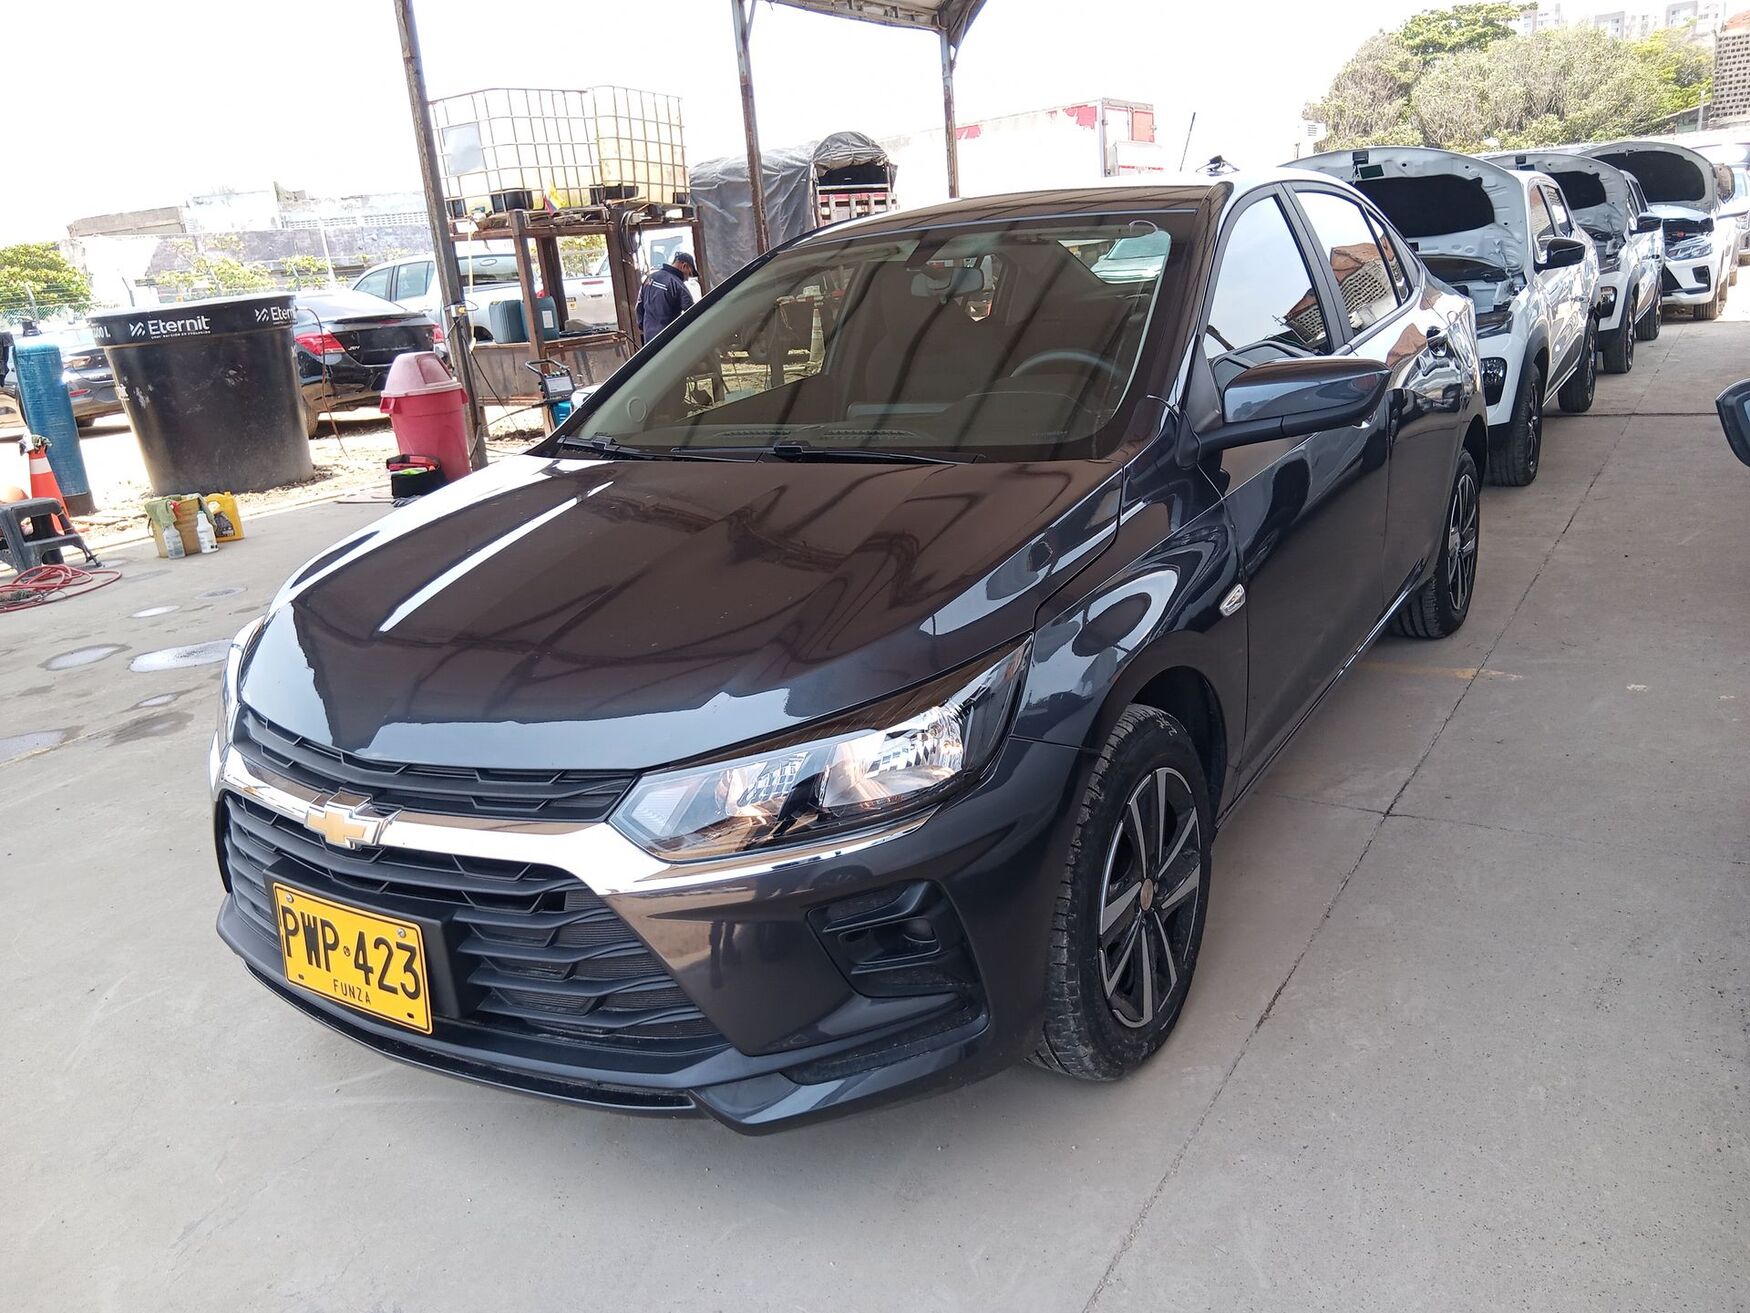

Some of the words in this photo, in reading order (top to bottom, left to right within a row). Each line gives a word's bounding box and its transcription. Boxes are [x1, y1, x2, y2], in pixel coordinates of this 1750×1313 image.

[147, 315, 211, 335] Eternit
[281, 905, 340, 973] PWP
[354, 930, 421, 1001] 423
[333, 979, 372, 1005] FUNZA
